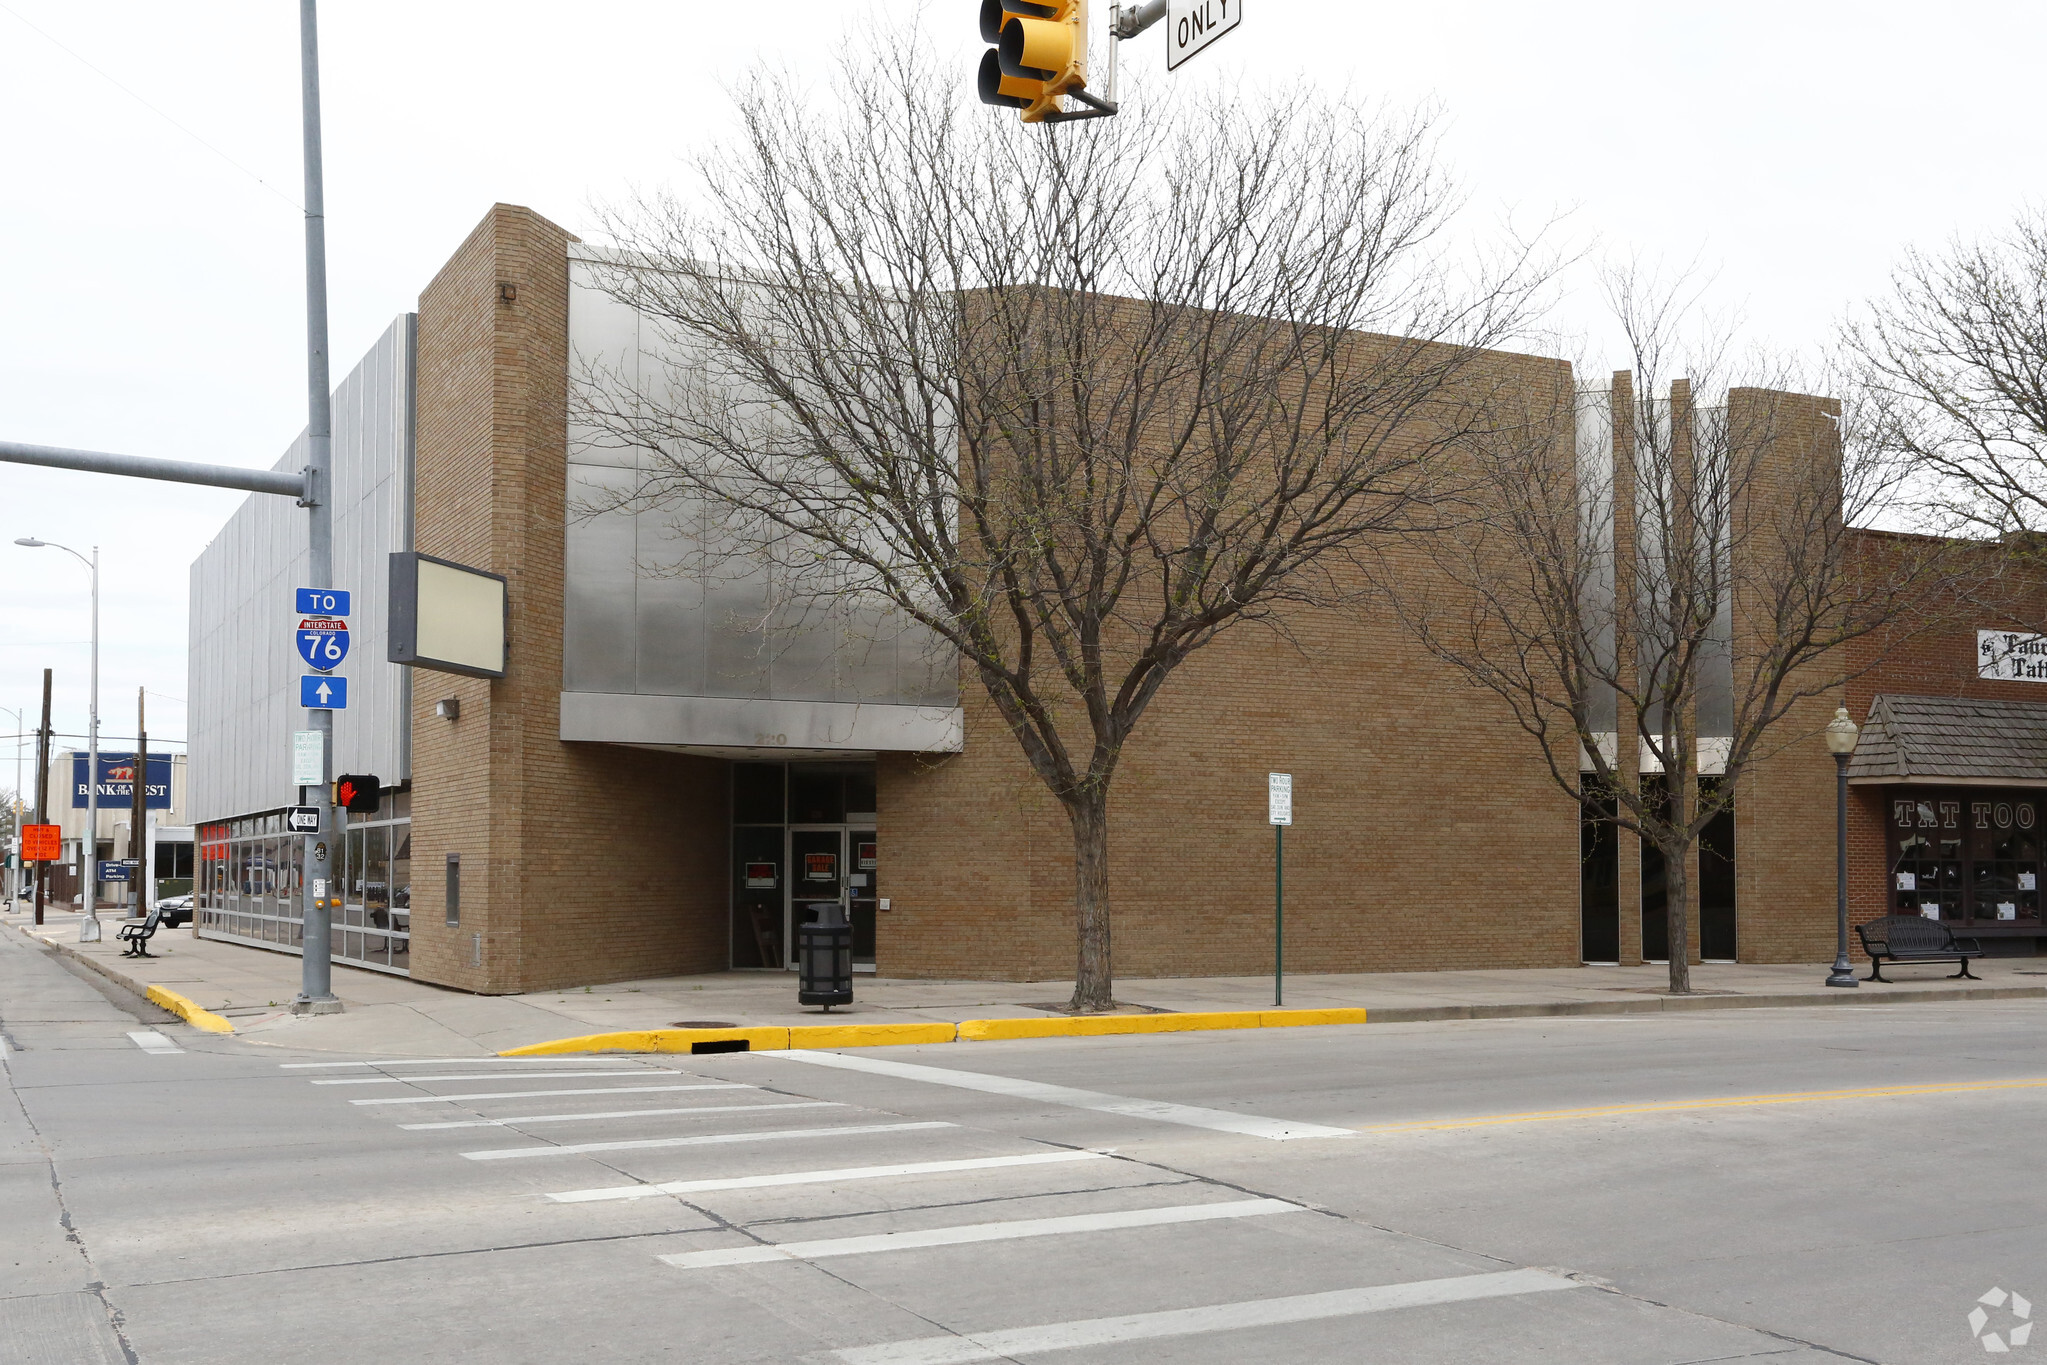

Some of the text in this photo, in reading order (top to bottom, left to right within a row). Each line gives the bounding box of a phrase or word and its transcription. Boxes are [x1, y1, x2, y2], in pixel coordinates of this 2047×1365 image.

[1178, 0, 1228, 48] ONLY
[310, 594, 336, 611] TO
[303, 621, 342, 630] INTERSTATE
[304, 635, 342, 660] 76
[1271, 785, 1291, 794] PARKING
[297, 815, 317, 826] ONE WAY
[807, 856, 834, 864] GARAGE
[812, 864, 830, 872] SALE
